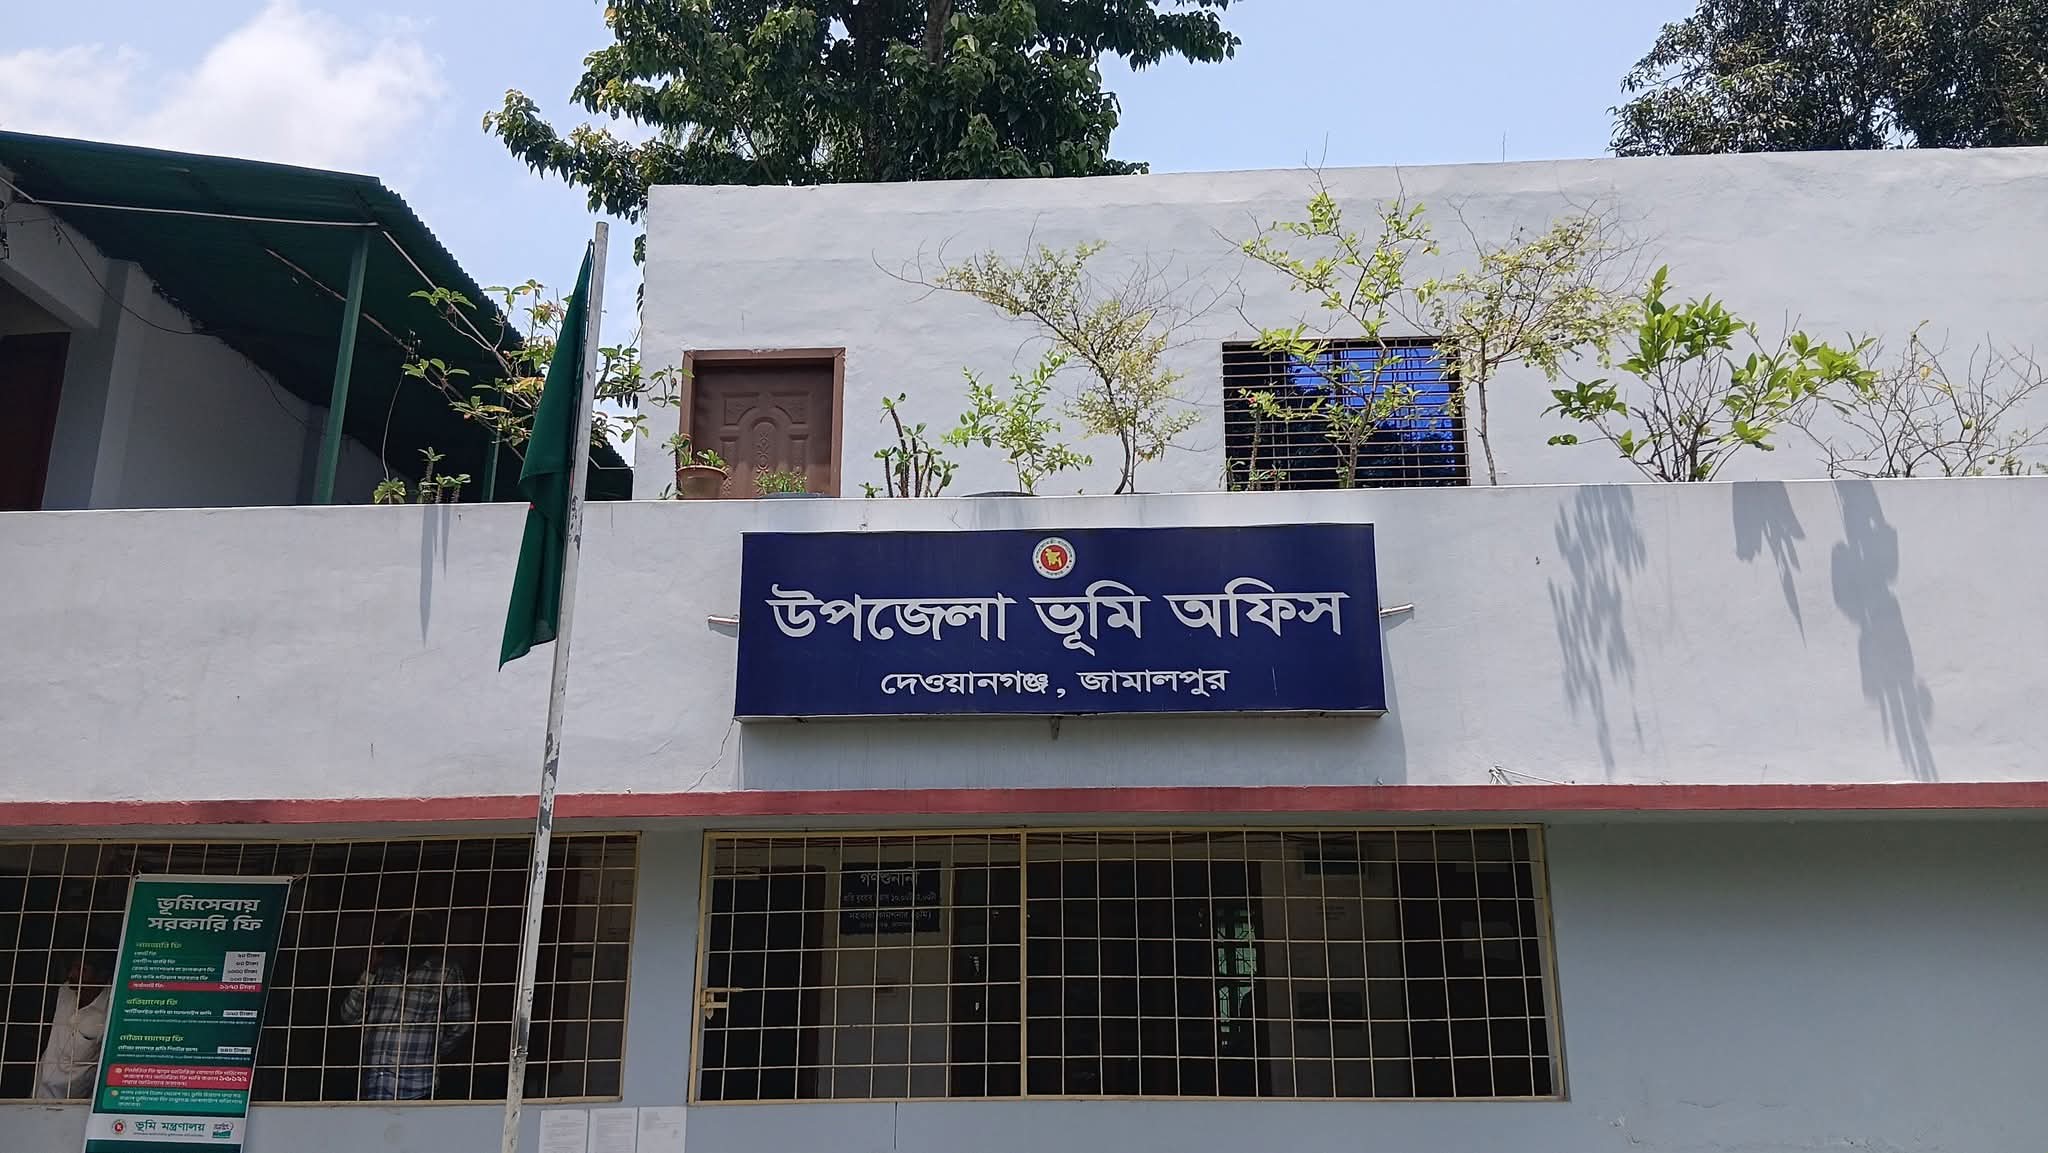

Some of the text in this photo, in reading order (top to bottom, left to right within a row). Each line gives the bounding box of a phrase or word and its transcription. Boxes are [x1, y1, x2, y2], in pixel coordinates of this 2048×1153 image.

[766, 576, 1351, 656] উপজেলা ভূমি অফিস
[1077, 669, 1230, 698] জামালপুর
[156, 895, 261, 915] ভূমিসেবায়
[147, 914, 263, 933] সরকারি ফি
[135, 1119, 156, 1132] ভূমি
[161, 1121, 206, 1132] মন্ত্রণালয়
